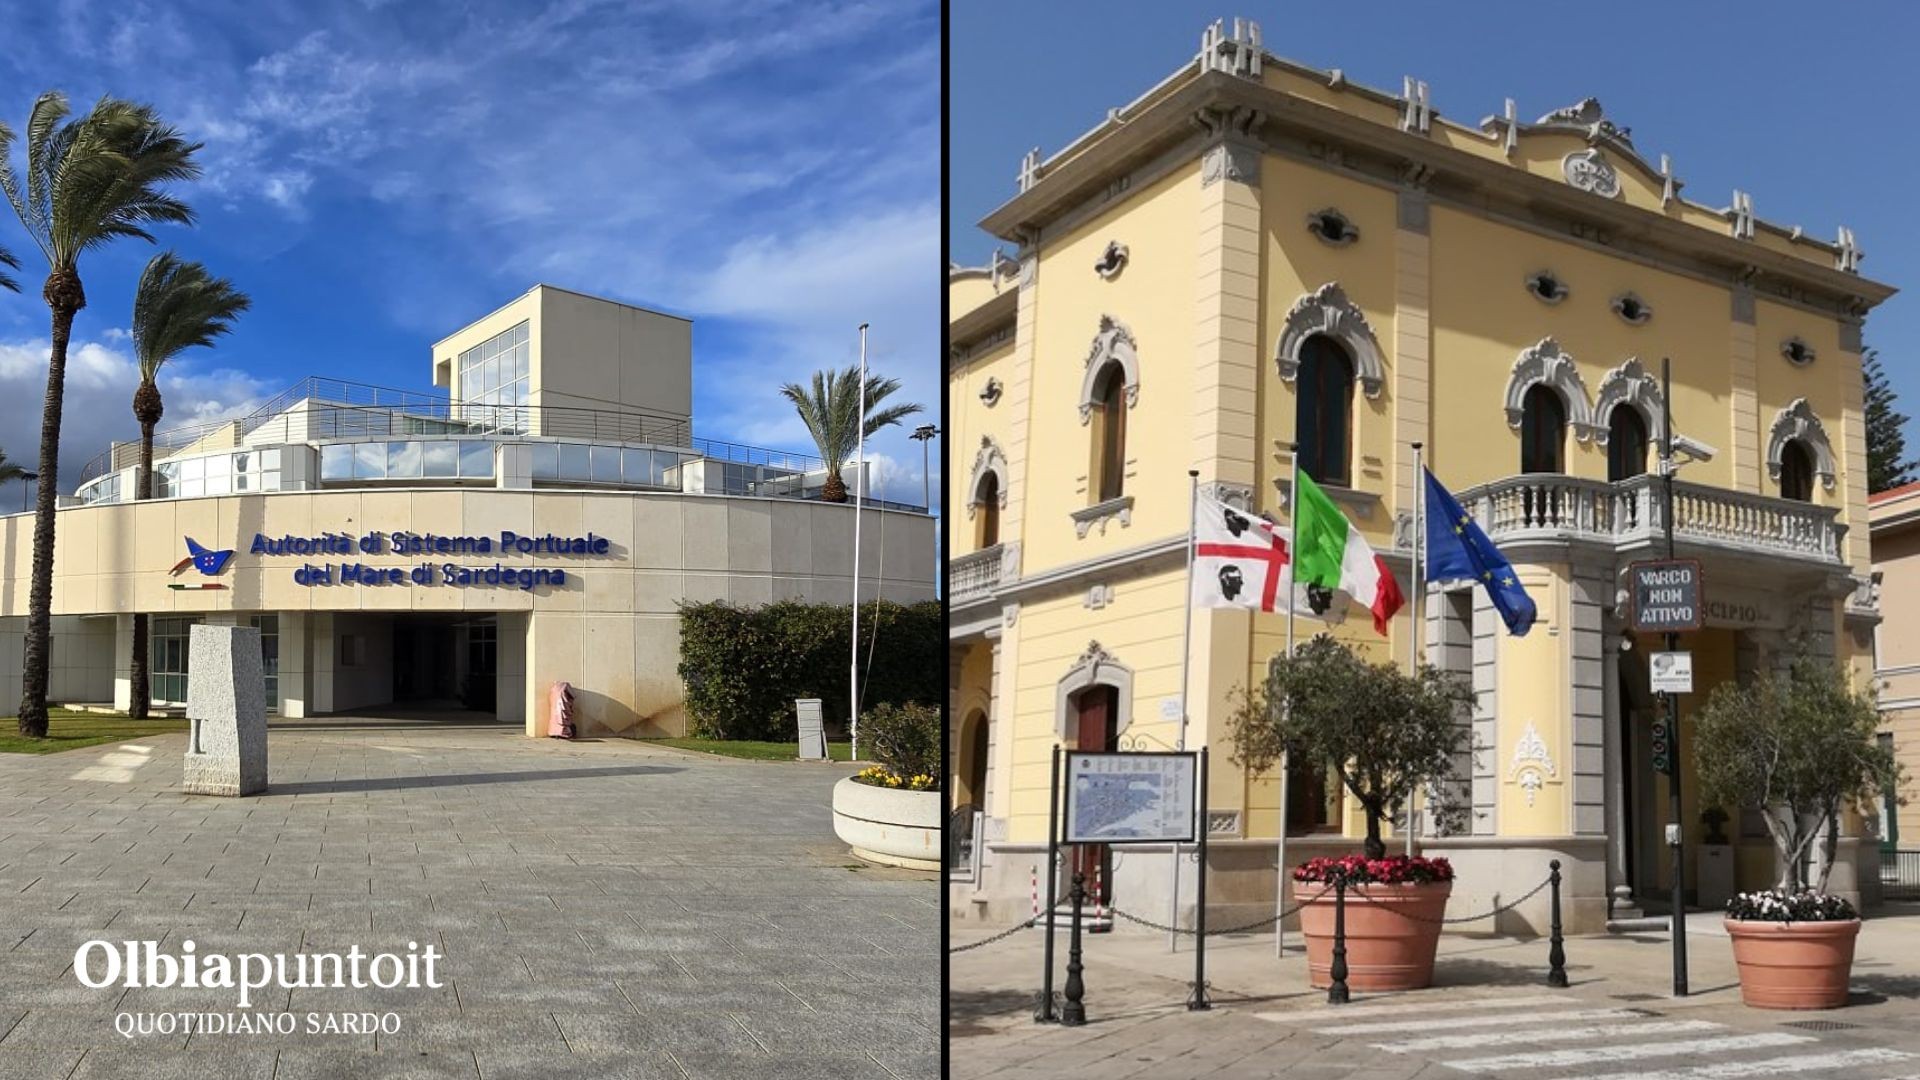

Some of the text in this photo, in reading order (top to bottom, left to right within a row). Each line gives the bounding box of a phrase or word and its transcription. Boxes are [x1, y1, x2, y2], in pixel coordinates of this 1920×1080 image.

[250, 531, 610, 555] Autorità di Sistema Portuale
[294, 562, 565, 590] del Mare di Sardegna
[1639, 569, 1692, 586] VARCO
[1648, 588, 1683, 604] NON
[1640, 605, 1693, 623] ATTIVO
